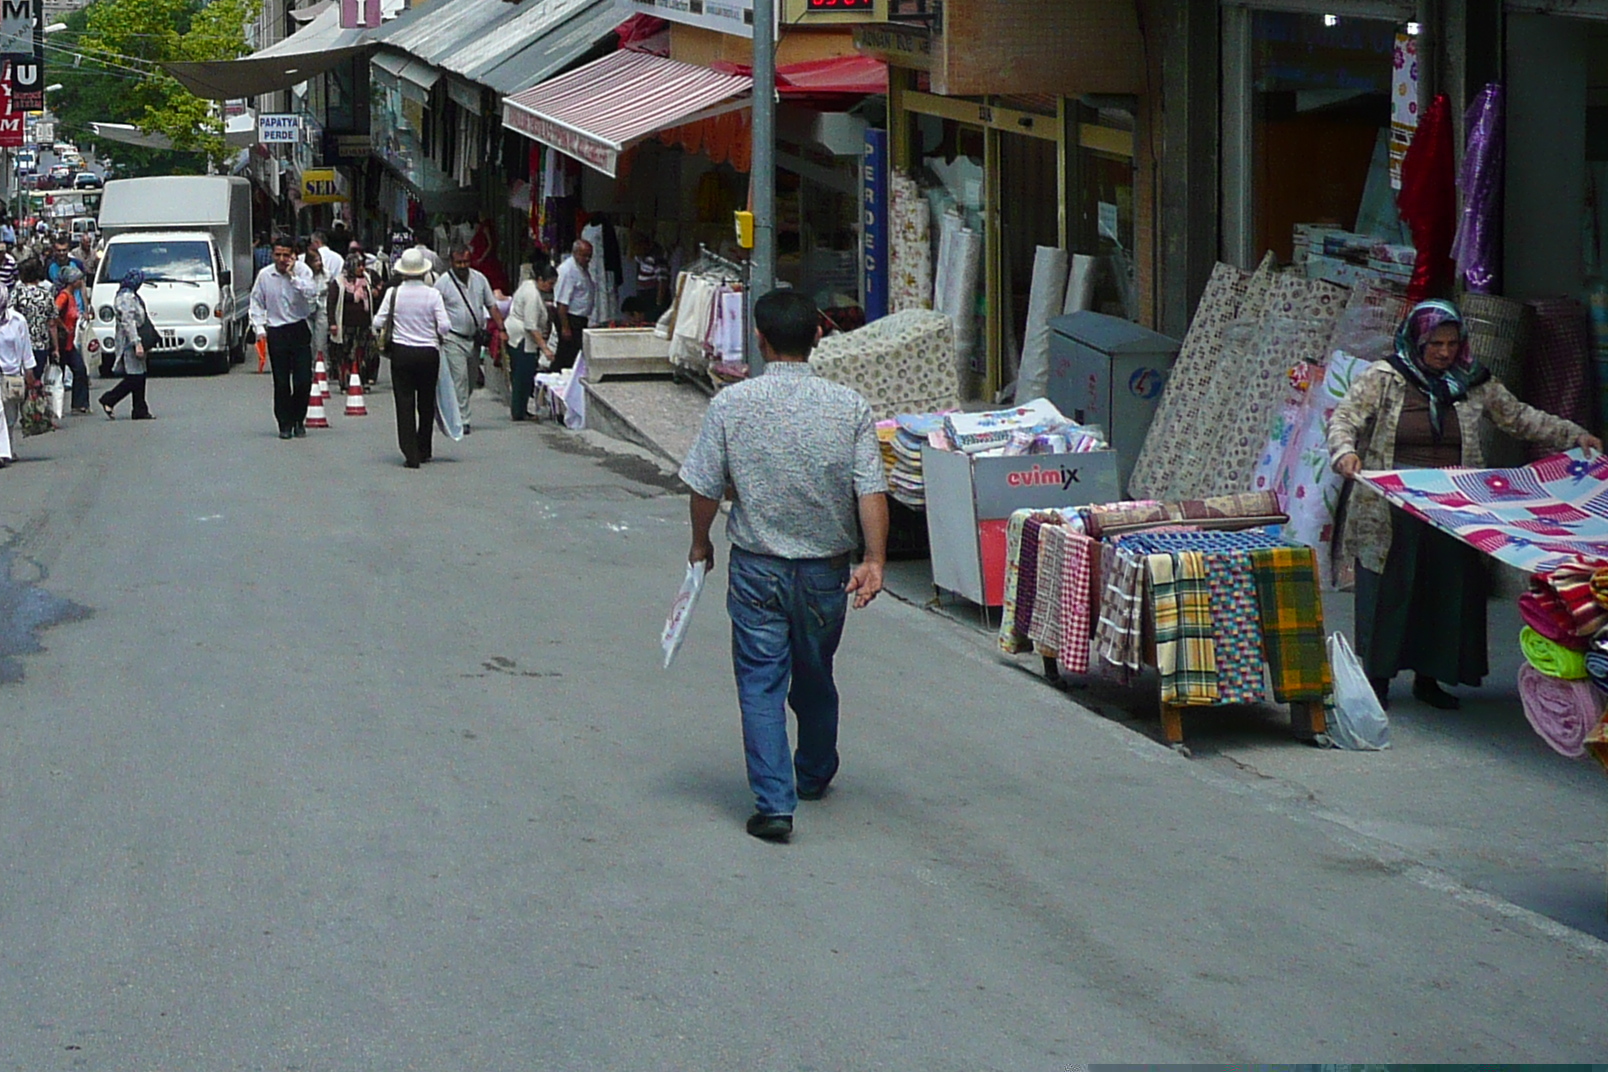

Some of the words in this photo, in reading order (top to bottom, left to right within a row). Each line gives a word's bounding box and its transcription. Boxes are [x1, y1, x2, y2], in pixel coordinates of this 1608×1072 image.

[260, 117, 298, 127] PAPATYA
[264, 131, 294, 140] PERDE
[1007, 464, 1080, 490] evimix
